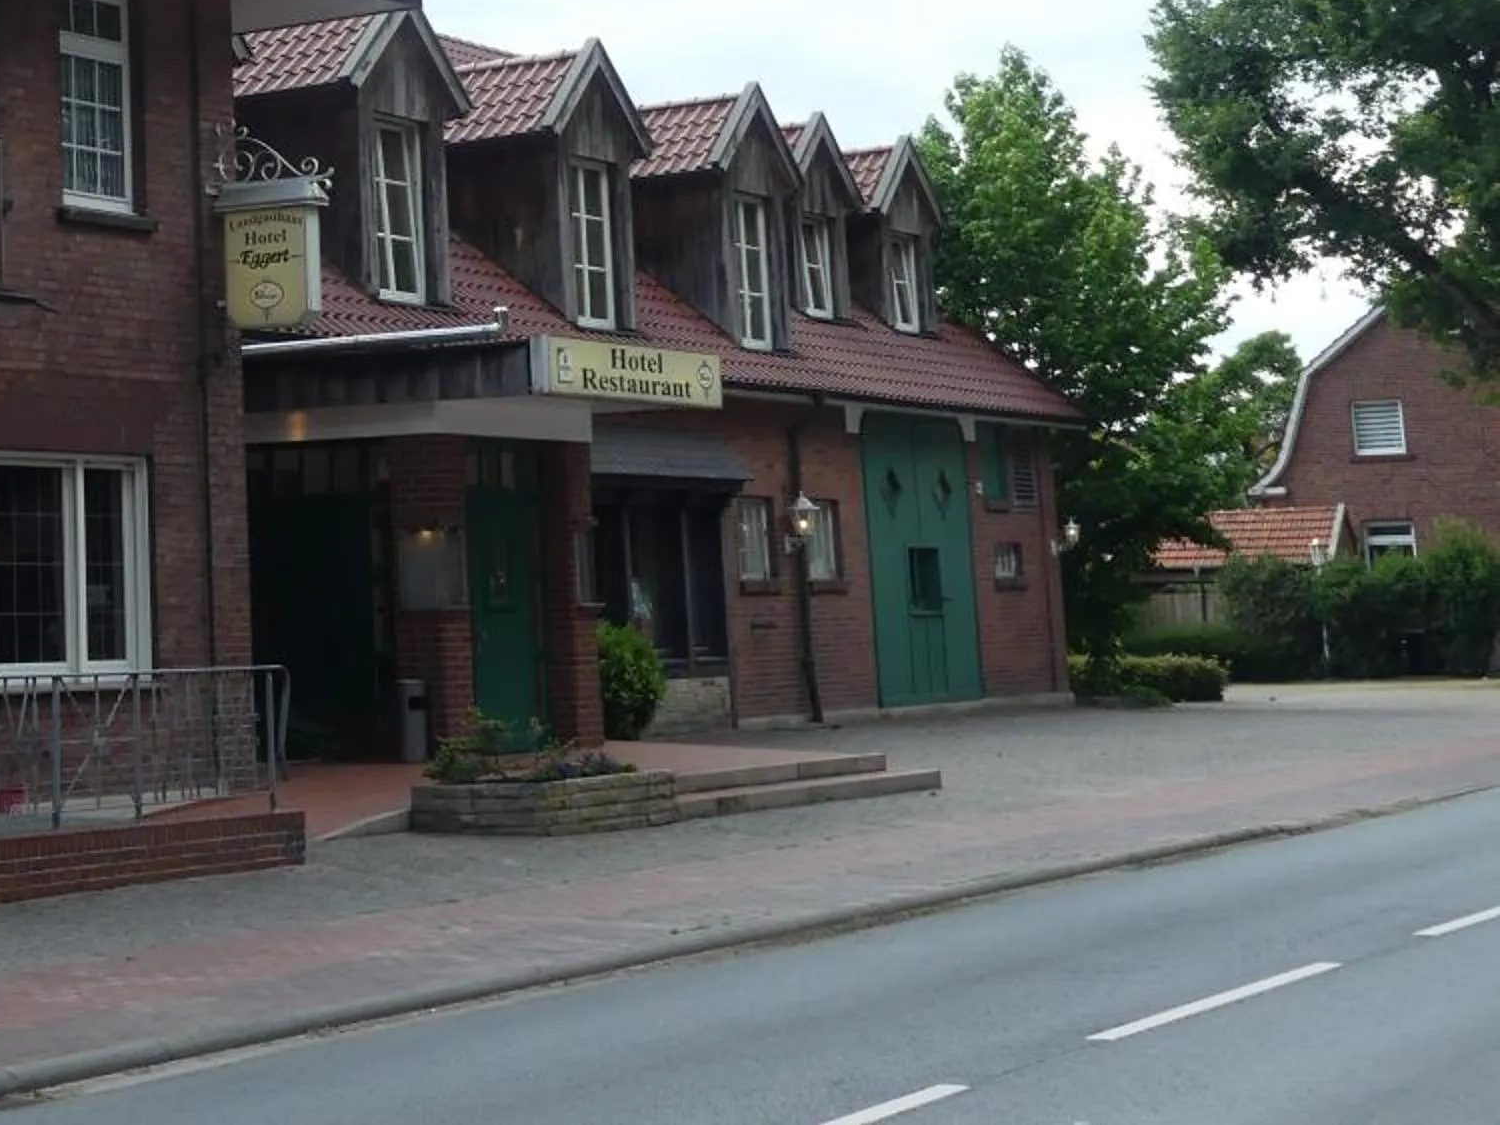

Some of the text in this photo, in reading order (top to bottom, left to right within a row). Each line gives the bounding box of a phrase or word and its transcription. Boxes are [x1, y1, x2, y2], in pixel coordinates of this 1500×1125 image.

[244, 228, 287, 246] Hotel
[239, 248, 290, 270] Eggert
[610, 348, 664, 374] Hotel
[581, 368, 692, 398] Restaurant
